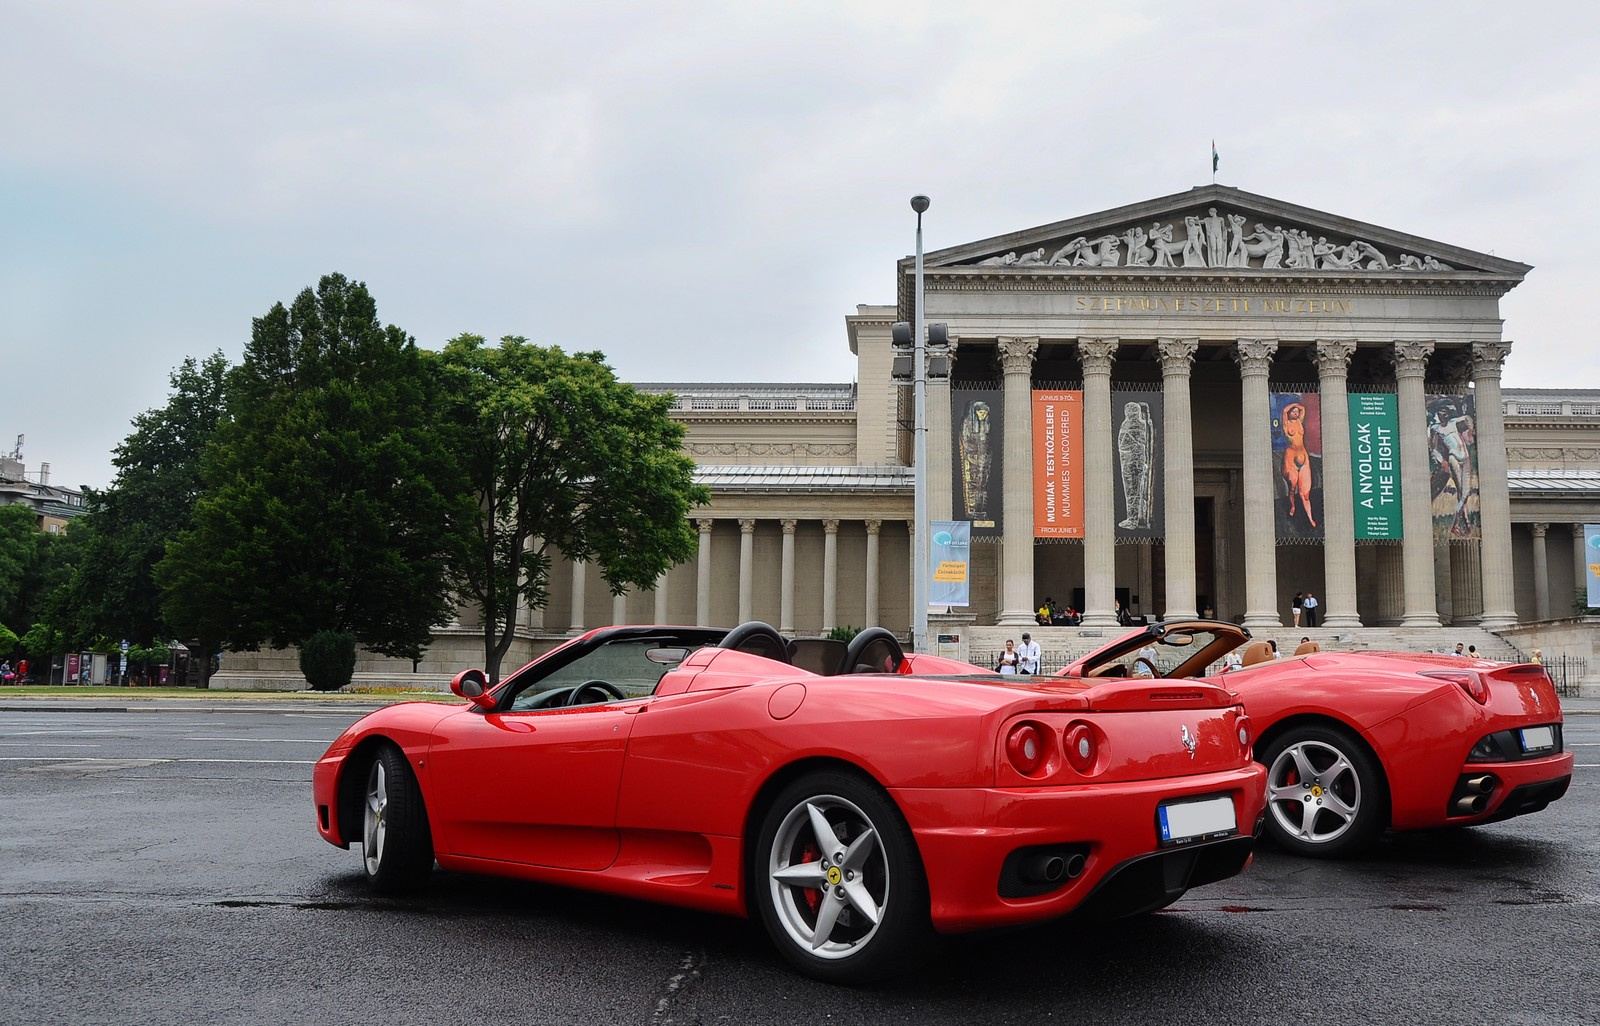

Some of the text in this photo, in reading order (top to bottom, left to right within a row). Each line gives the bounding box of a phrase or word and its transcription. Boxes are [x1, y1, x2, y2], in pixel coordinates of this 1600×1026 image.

[1045, 405, 1055, 522] MÚMIÁK TESTKÖZELBEN
[1061, 409, 1071, 518] MUMMIES UNCOVERED
[1357, 423, 1374, 509] A NYOLCAK
[1377, 426, 1394, 506] THE EIGHT
[1162, 825, 1168, 835] H
